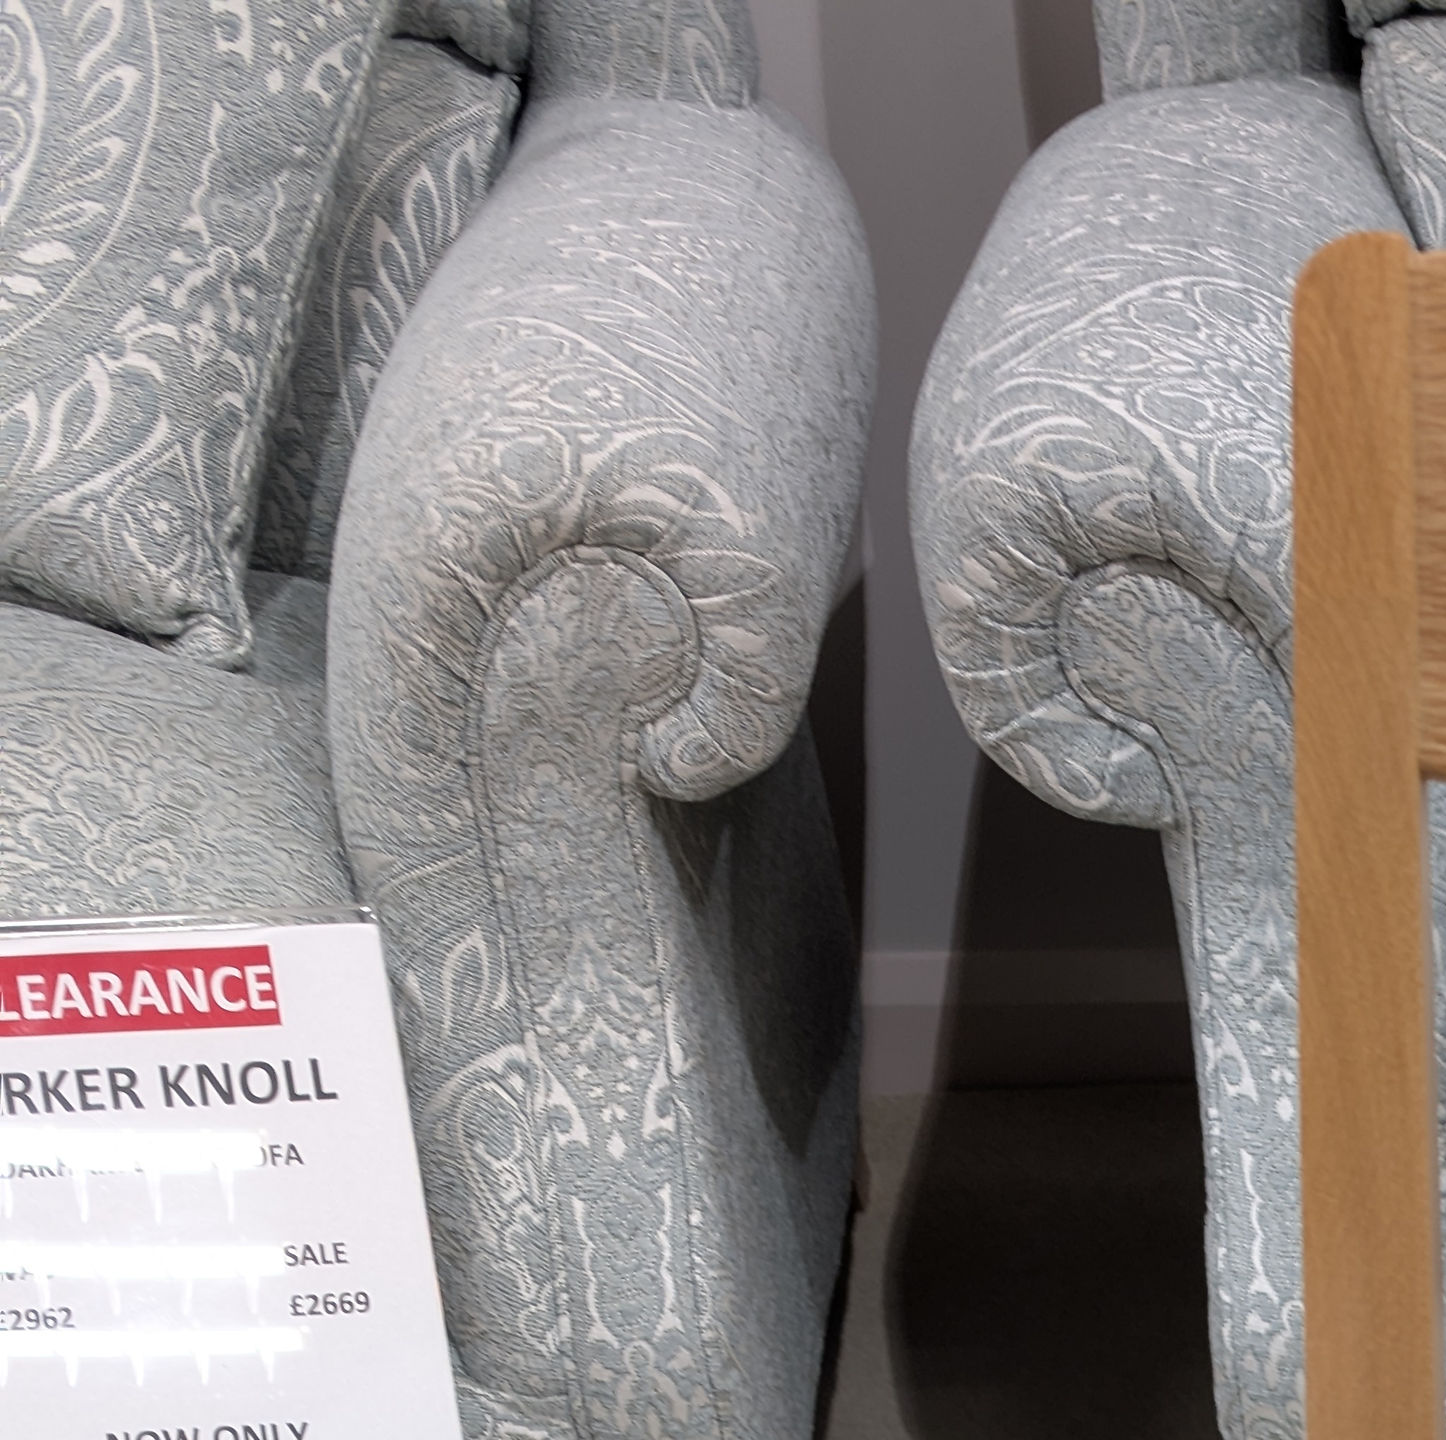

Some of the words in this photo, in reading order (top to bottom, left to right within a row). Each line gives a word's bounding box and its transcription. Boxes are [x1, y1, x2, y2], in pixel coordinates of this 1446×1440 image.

[0, 1068, 145, 1116] RKER
[158, 1058, 338, 1108] KNOLL
[284, 1242, 349, 1267] SALE
[289, 1291, 370, 1317] £2669
